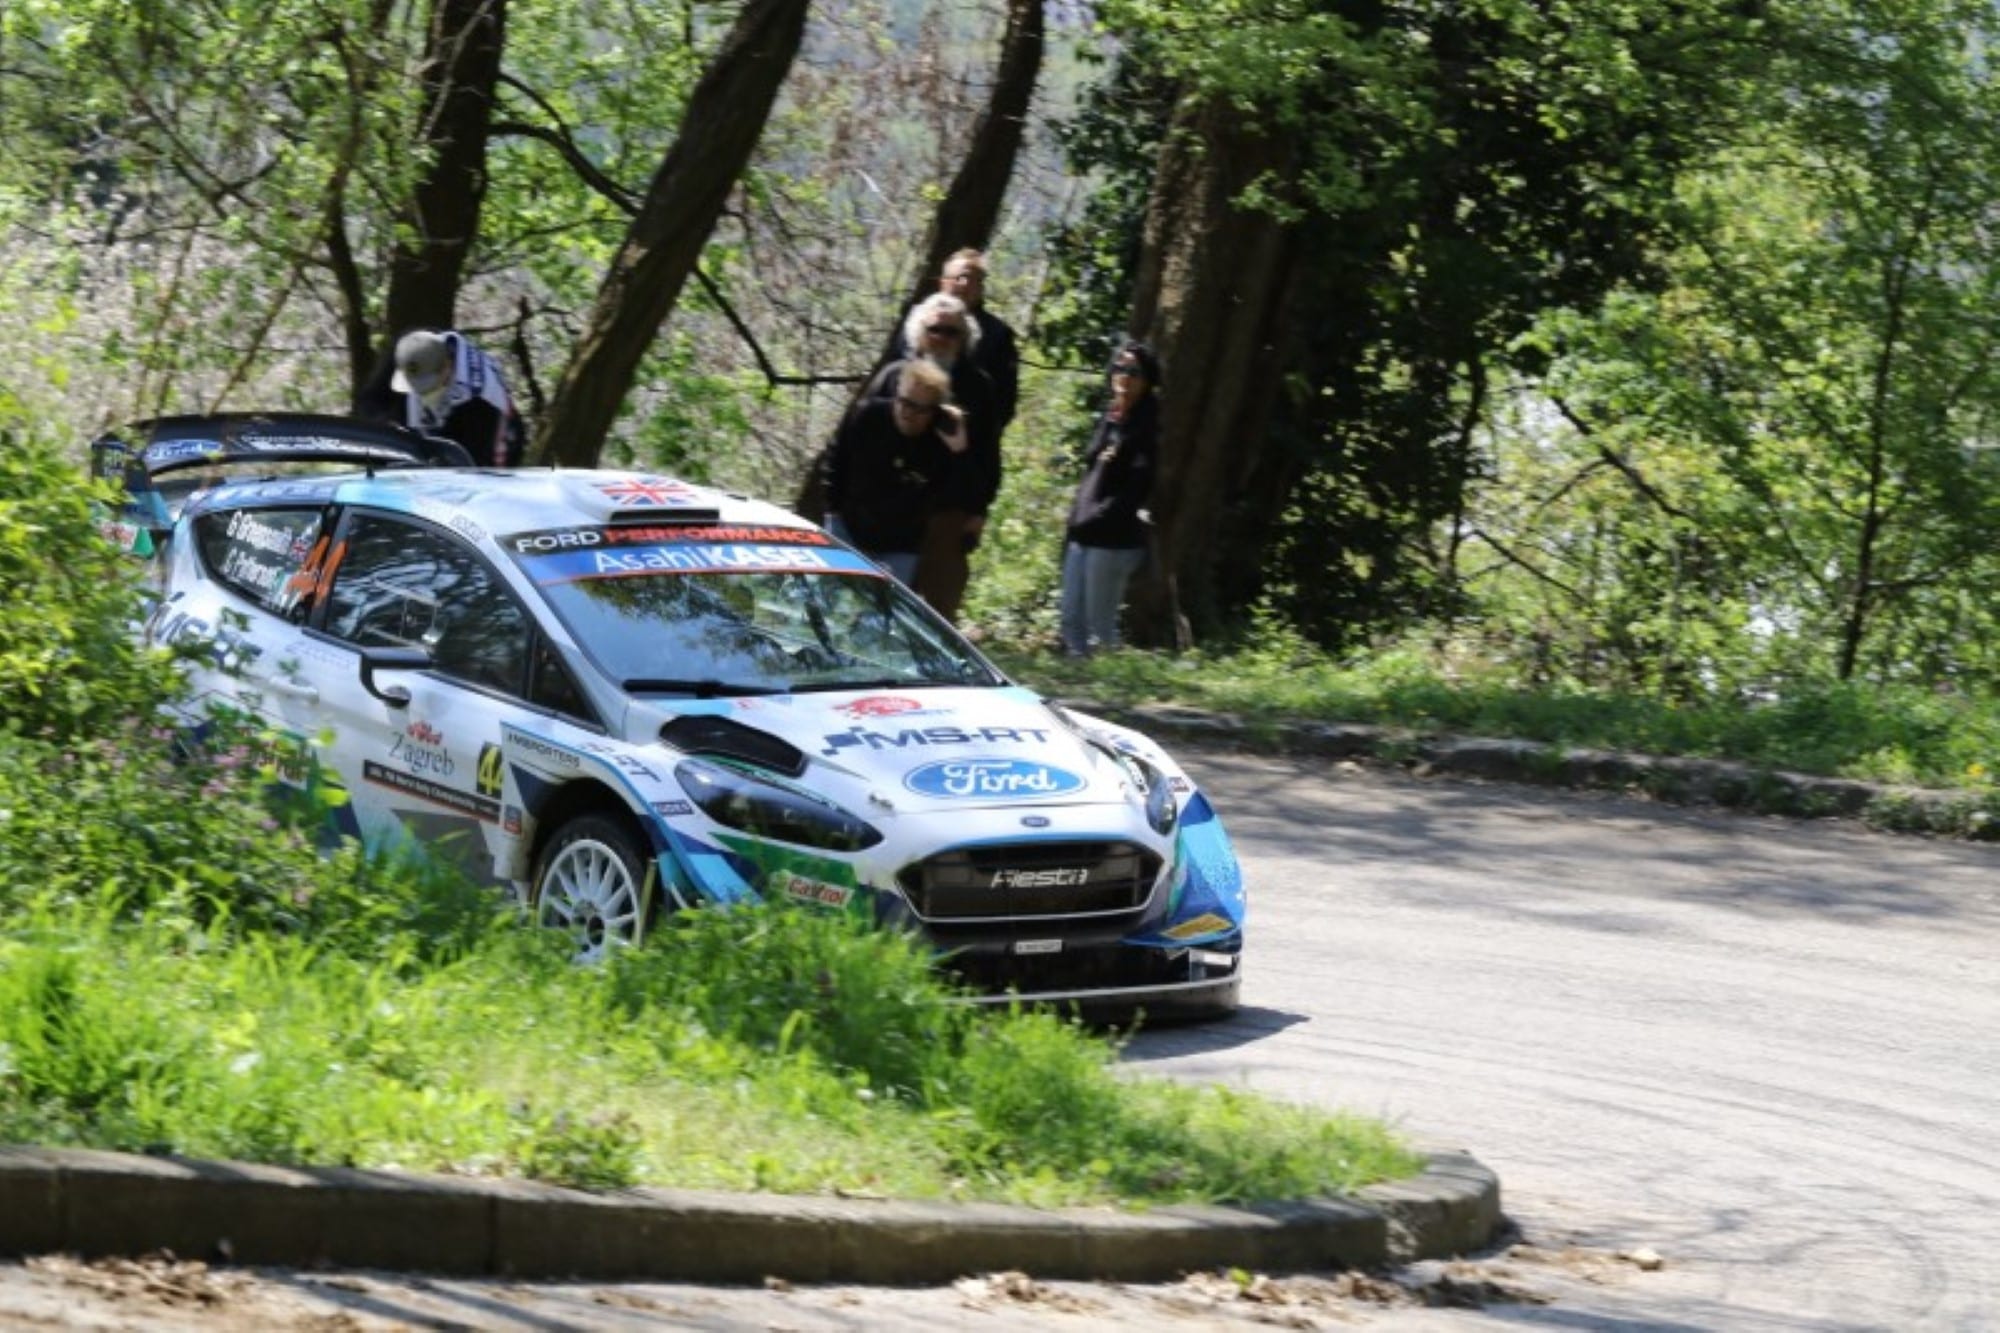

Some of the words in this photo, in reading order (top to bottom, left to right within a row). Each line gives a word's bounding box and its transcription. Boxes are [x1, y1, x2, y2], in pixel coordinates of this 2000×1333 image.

[516, 531, 600, 552] FORD
[860, 727, 1050, 749] MS-RT
[390, 731, 455, 776] Zagreb
[942, 761, 1058, 795] Ford
